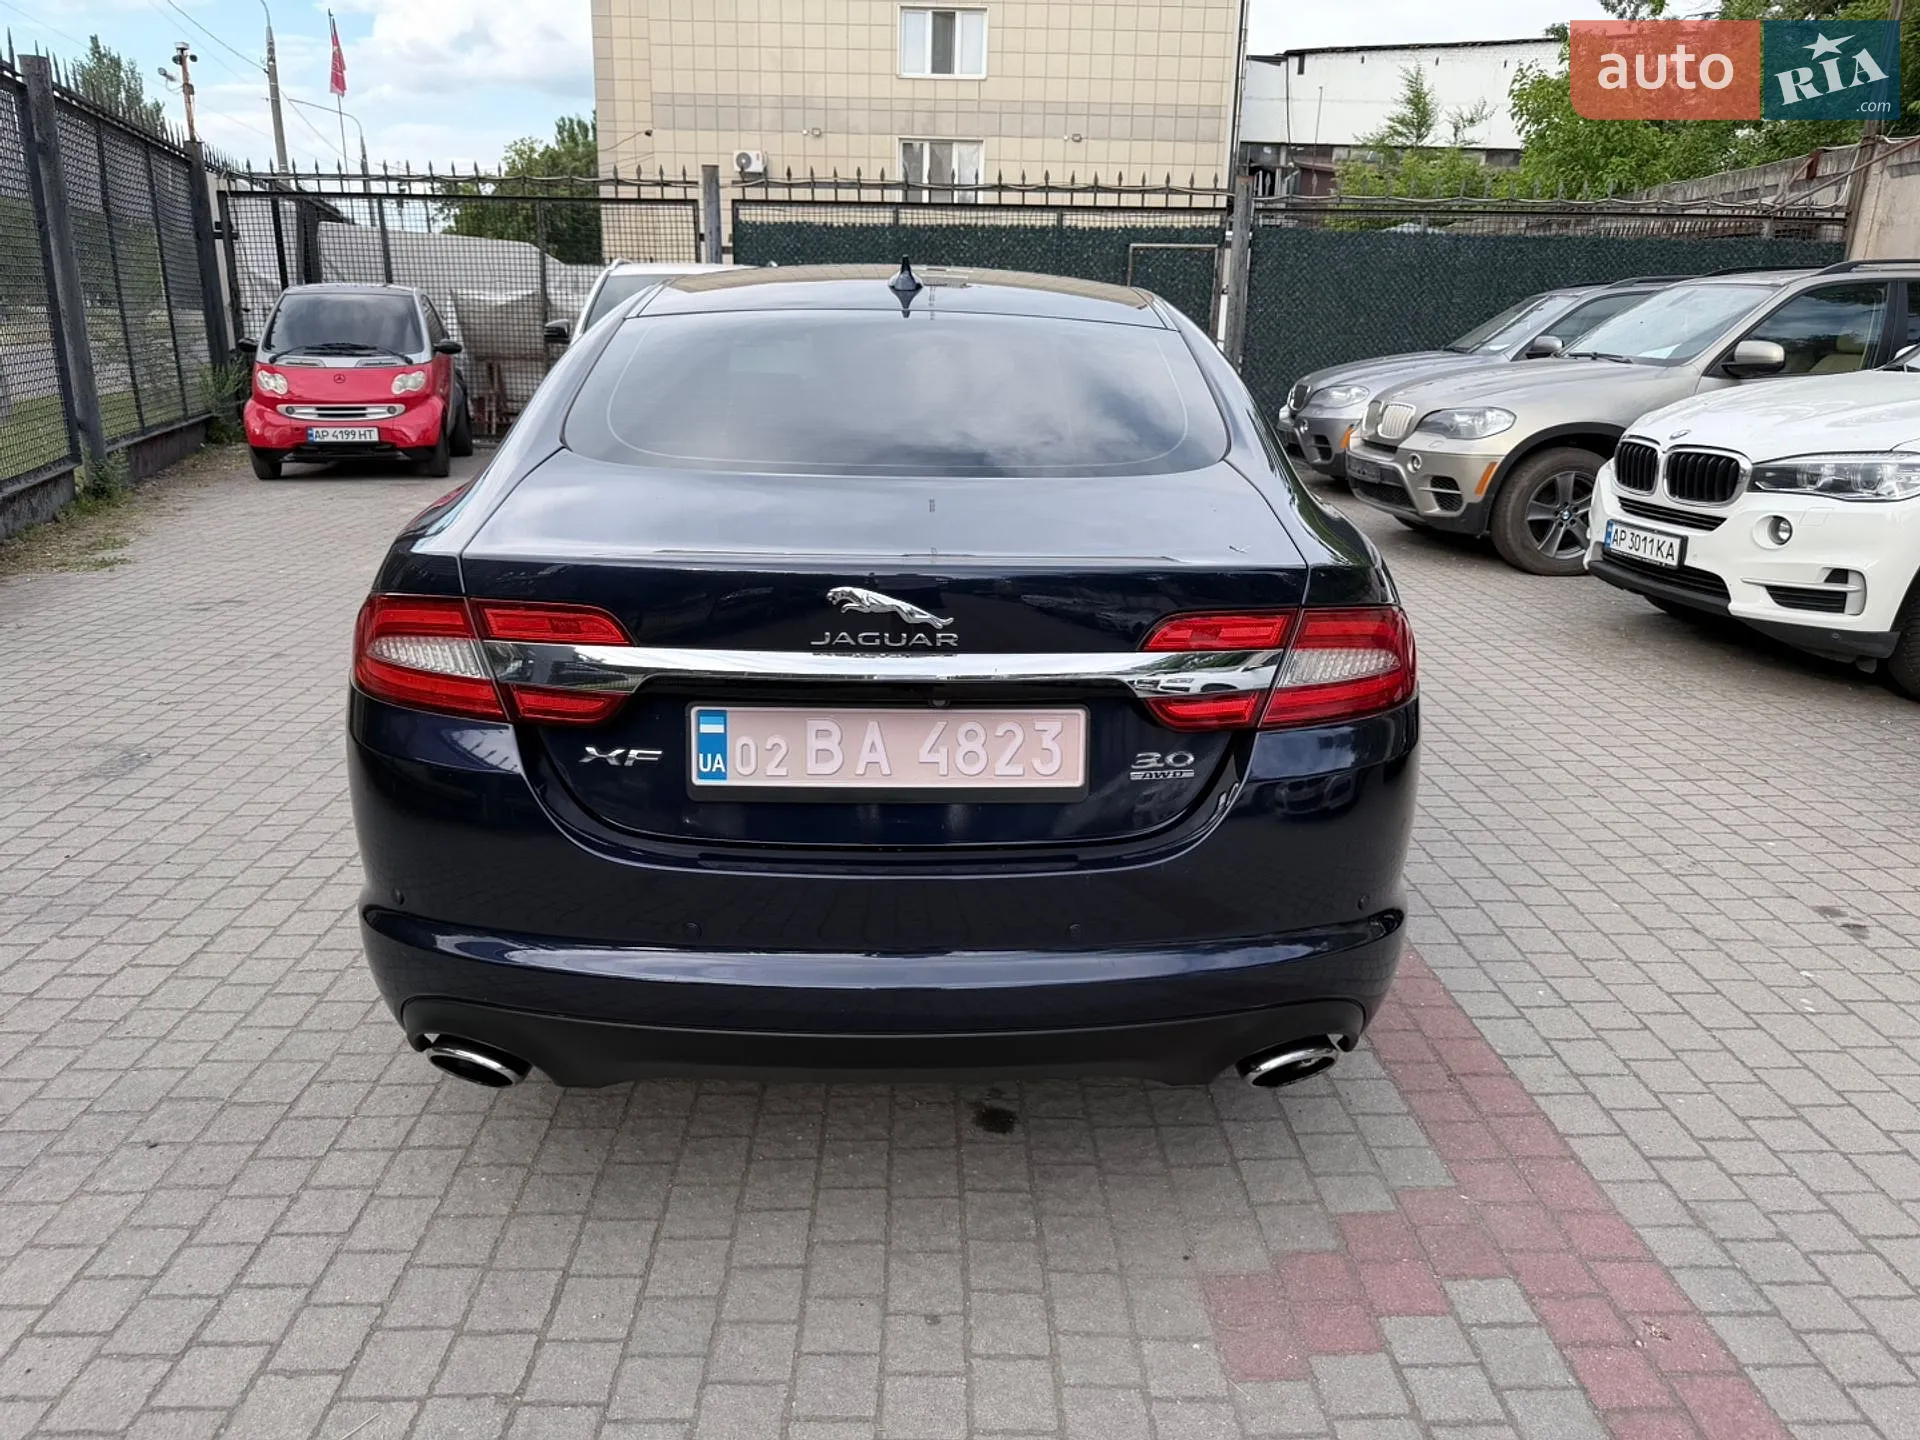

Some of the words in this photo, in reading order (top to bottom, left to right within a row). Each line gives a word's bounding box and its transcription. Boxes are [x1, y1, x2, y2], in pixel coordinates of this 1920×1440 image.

[314, 430, 329, 440] AP
[332, 430, 356, 440] 4199
[359, 430, 374, 440] HT
[1612, 527, 1627, 547] AP
[810, 631, 959, 647] JAGUAR
[578, 746, 663, 767] XF
[735, 735, 789, 776] 02
[806, 718, 892, 776] BA
[918, 720, 1063, 776] 4823
[699, 753, 726, 773] UA
